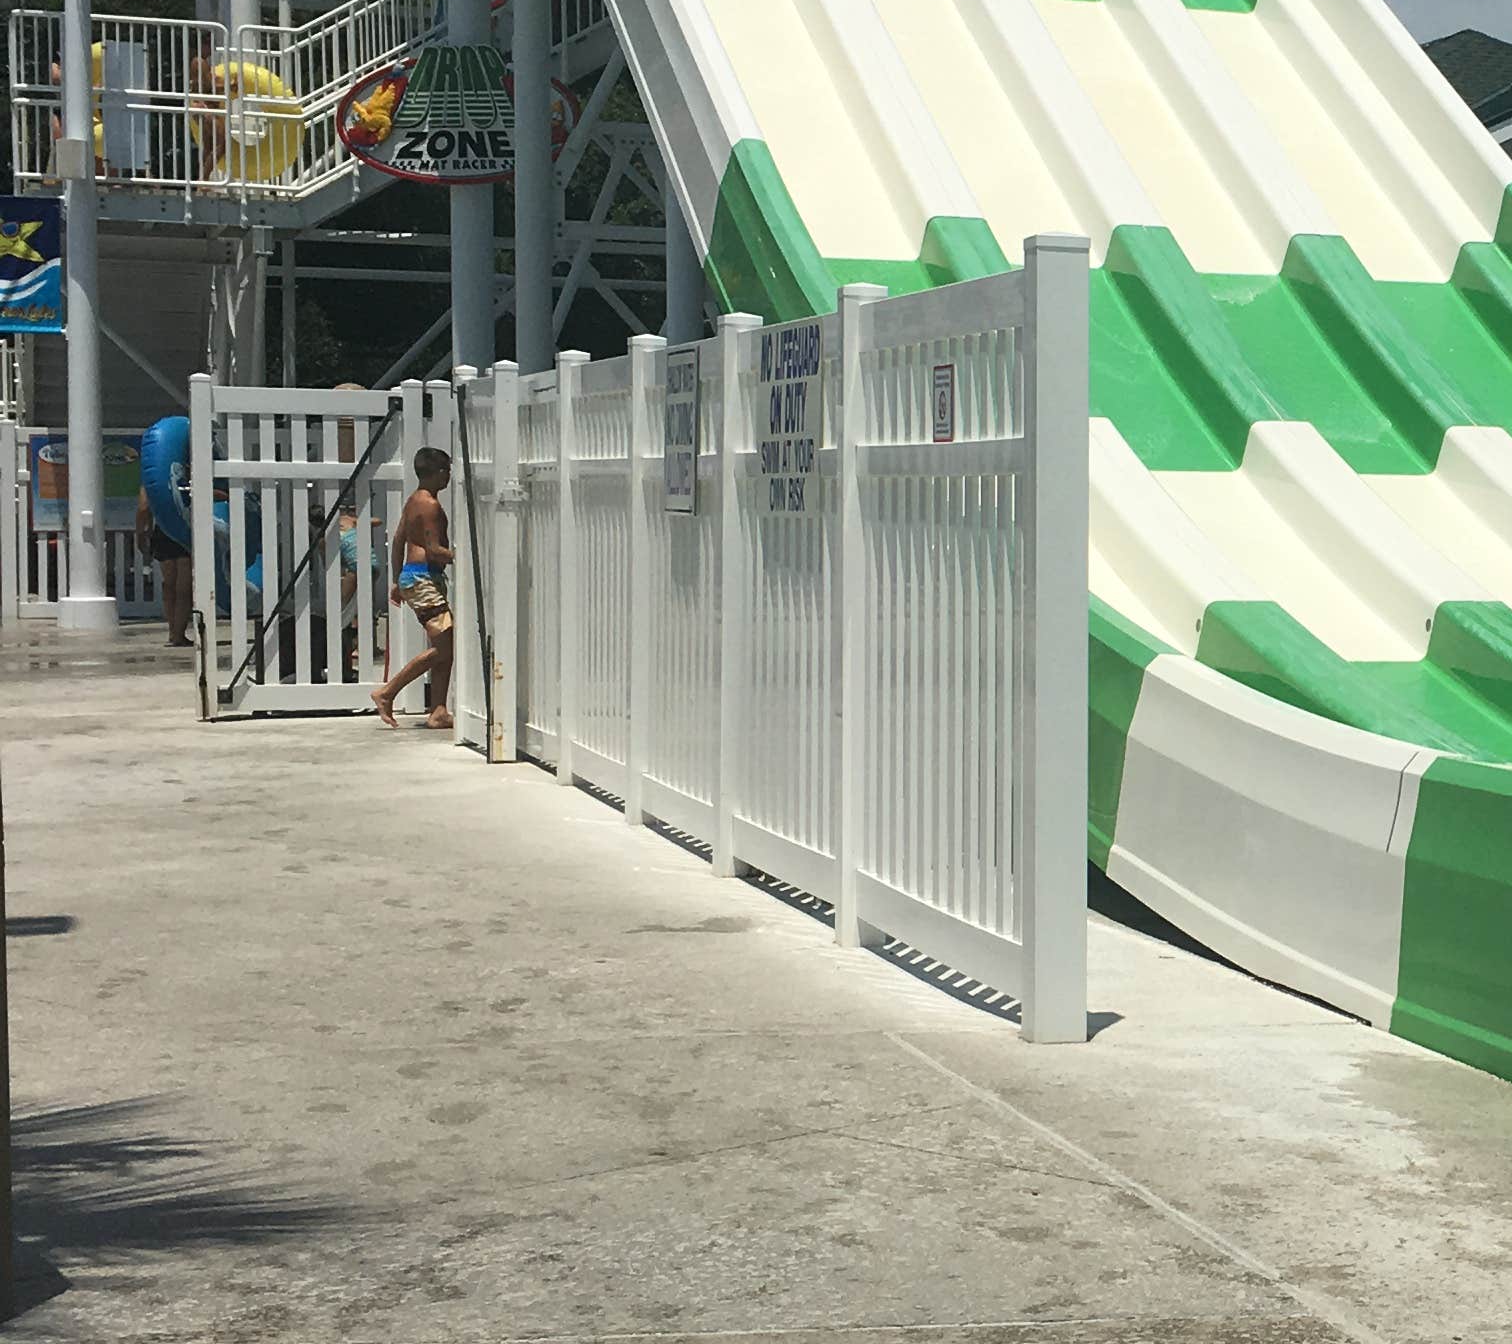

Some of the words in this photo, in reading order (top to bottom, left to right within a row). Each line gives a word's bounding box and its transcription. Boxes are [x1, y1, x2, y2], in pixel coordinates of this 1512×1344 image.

[396, 131, 515, 159] ZONE
[419, 159, 447, 170] MAT
[452, 159, 497, 170] RACER
[760, 334, 773, 383] NO
[775, 325, 820, 380] LIFEGUARD
[770, 385, 782, 435] ON
[785, 382, 807, 434] DUTY
[761, 440, 780, 474] SWIM
[782, 440, 791, 474] AT
[794, 439, 815, 474] YOUR
[769, 478, 786, 512] OWN
[788, 478, 805, 512] RISK
